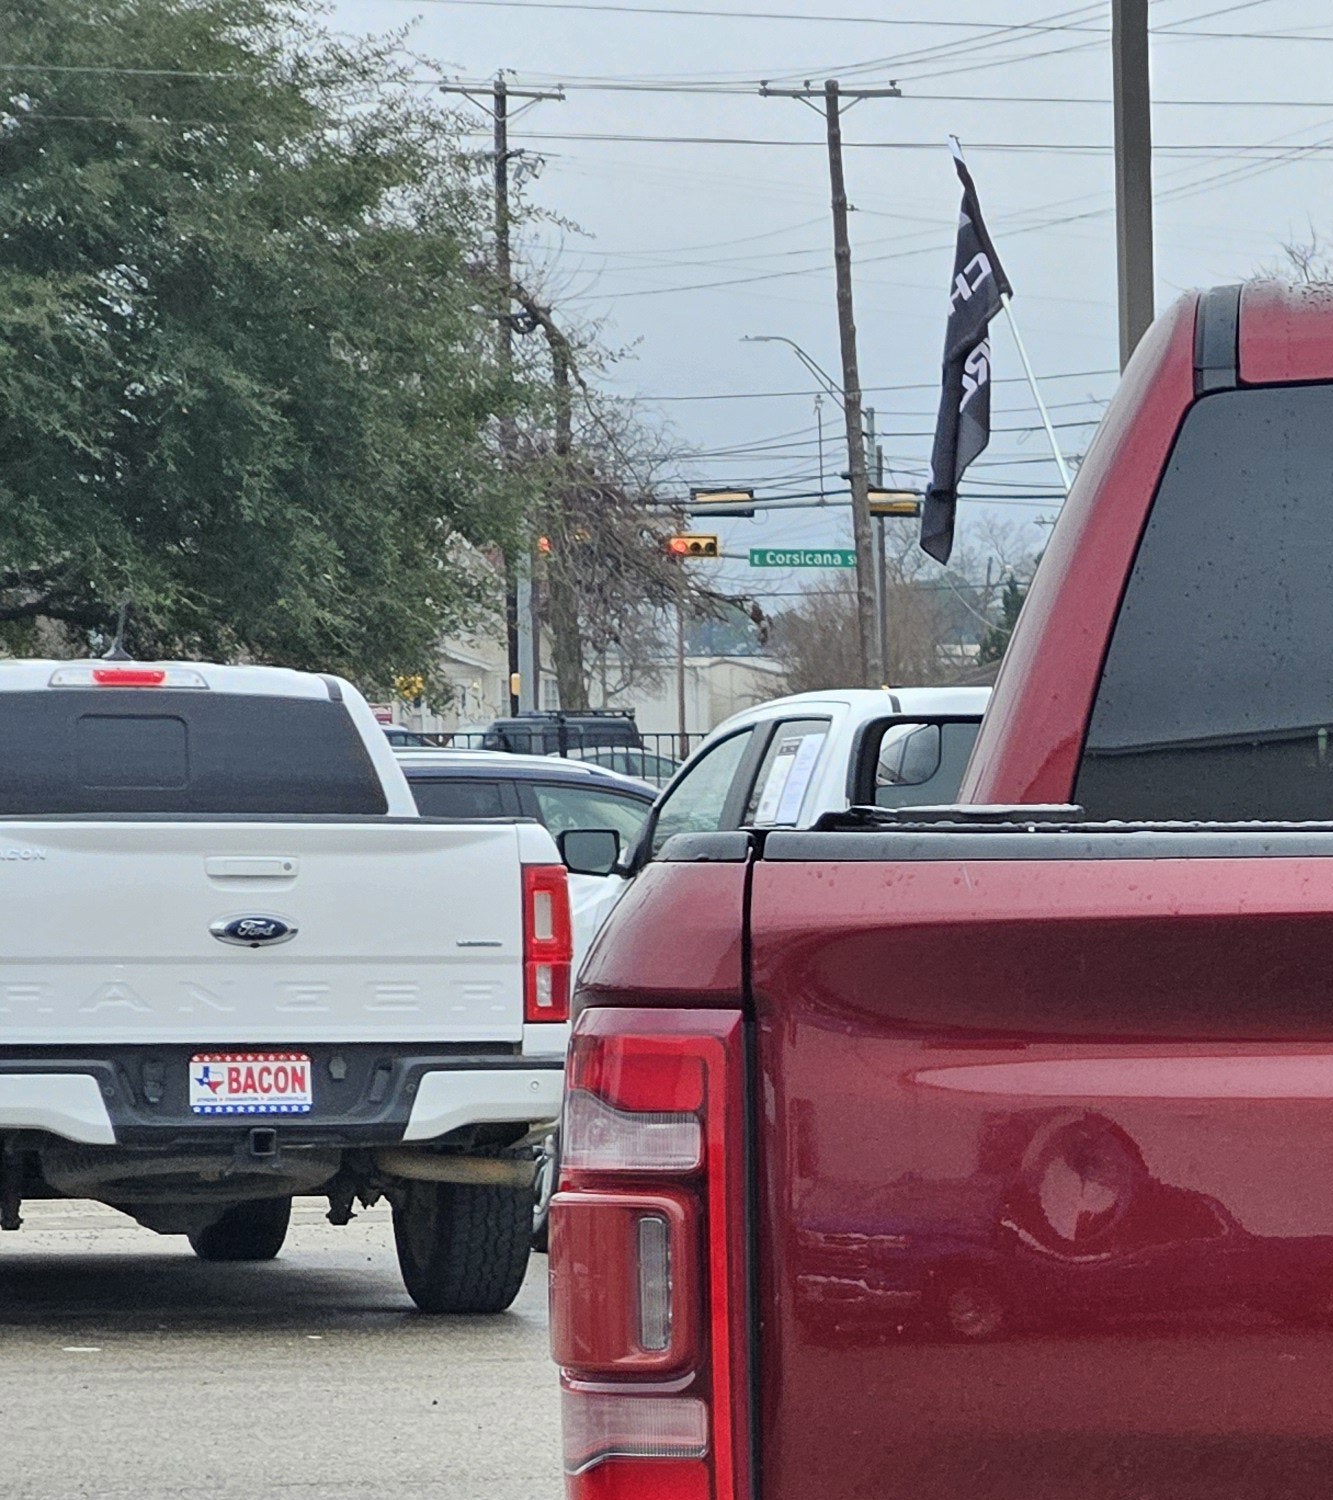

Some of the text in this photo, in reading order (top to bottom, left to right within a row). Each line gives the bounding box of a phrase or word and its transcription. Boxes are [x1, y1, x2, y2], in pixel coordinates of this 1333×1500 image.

[753, 554, 760, 565] E
[766, 551, 842, 565] Corsicana
[237, 919, 276, 936] Ford
[227, 1065, 306, 1094] BACON
